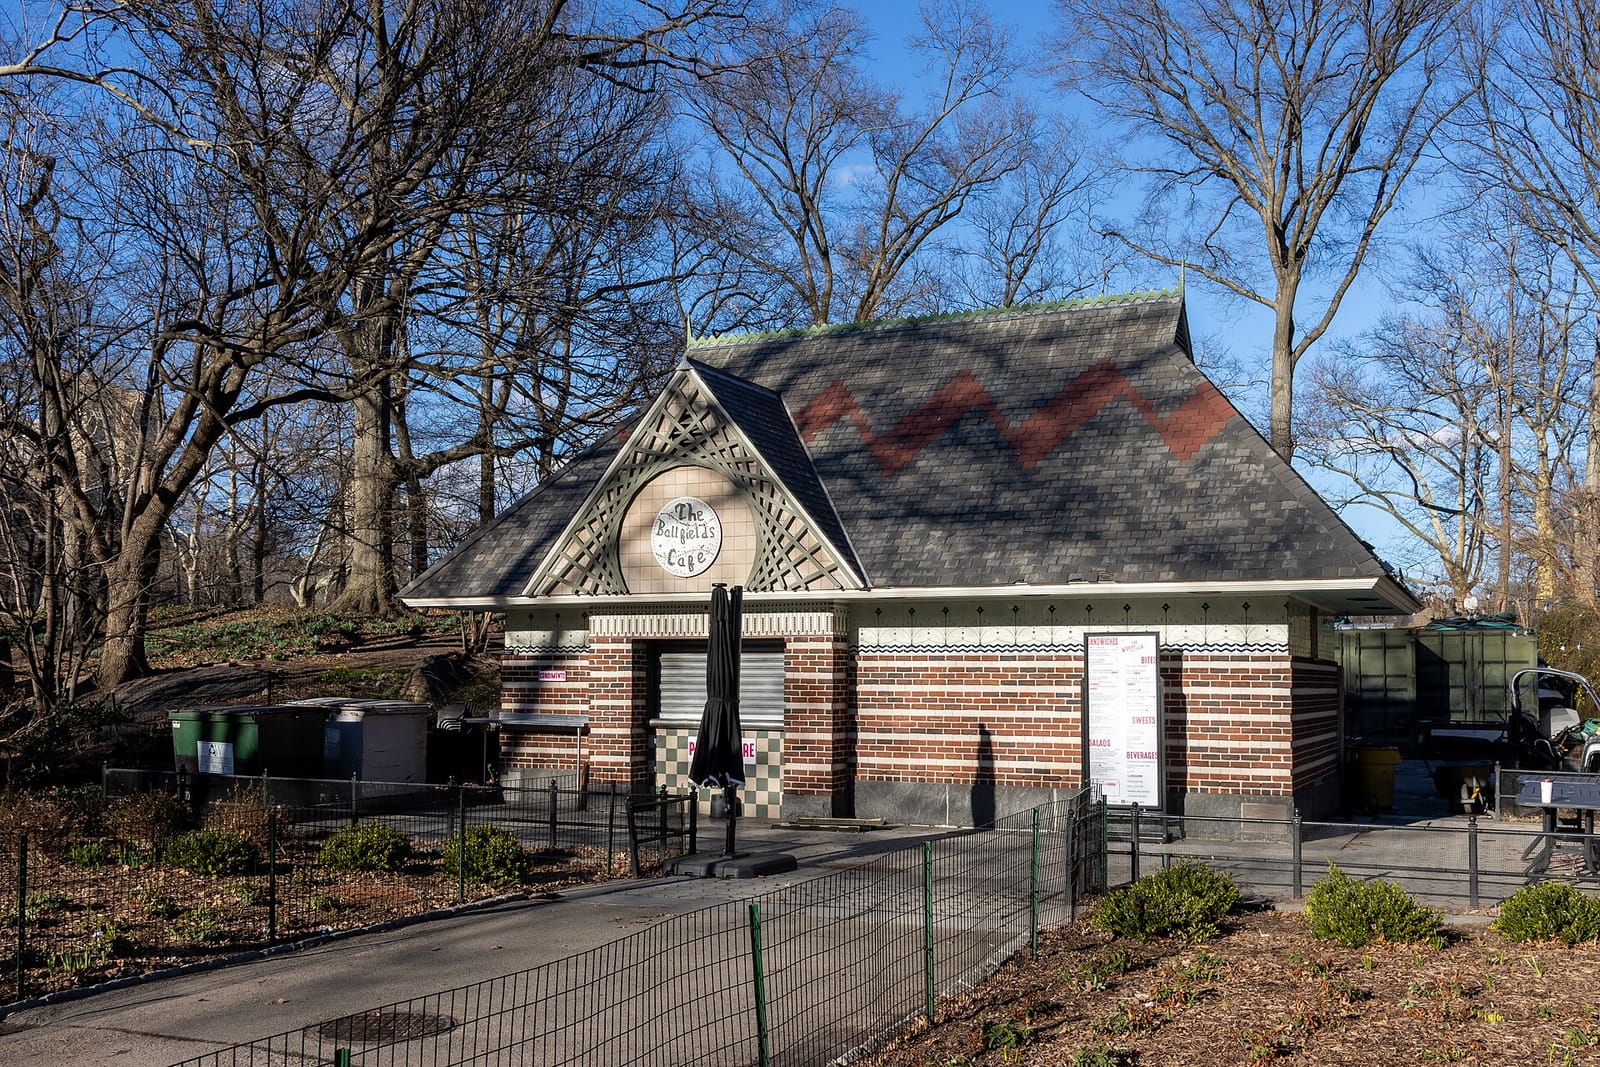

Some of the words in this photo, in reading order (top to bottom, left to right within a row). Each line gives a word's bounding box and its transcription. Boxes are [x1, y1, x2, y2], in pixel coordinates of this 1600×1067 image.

[674, 502, 705, 522] The
[656, 518, 715, 545] Ballfields
[1132, 716, 1156, 725] SWEETS
[1088, 739, 1112, 748] SALADS
[742, 743, 755, 758] RE
[1126, 751, 1160, 760] BEVERAGES
